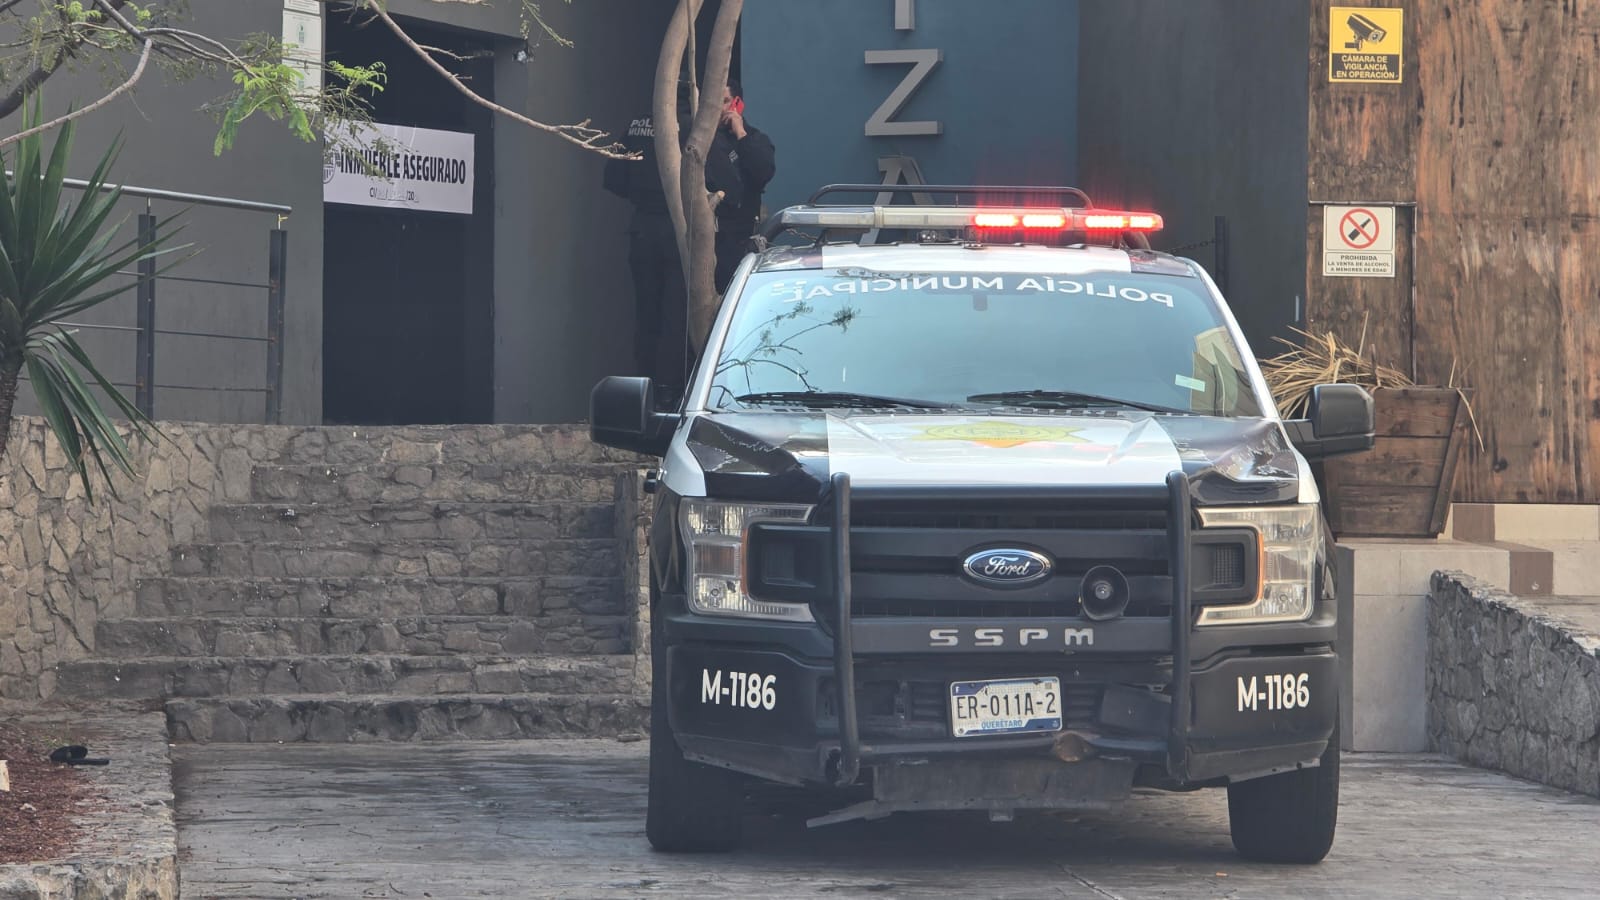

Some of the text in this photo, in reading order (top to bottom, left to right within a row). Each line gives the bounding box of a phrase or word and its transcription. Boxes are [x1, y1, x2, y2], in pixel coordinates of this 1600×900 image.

[1343, 63, 1388, 71] VIGILANCIA
[1377, 55, 1388, 63] DE
[630, 118, 652, 128] POL
[402, 153, 466, 185] ASEGURADO
[984, 555, 1031, 576] Ford
[701, 668, 777, 711] M-1186
[1237, 672, 1310, 712] M-1186
[957, 691, 1057, 719] ER-011A-2
